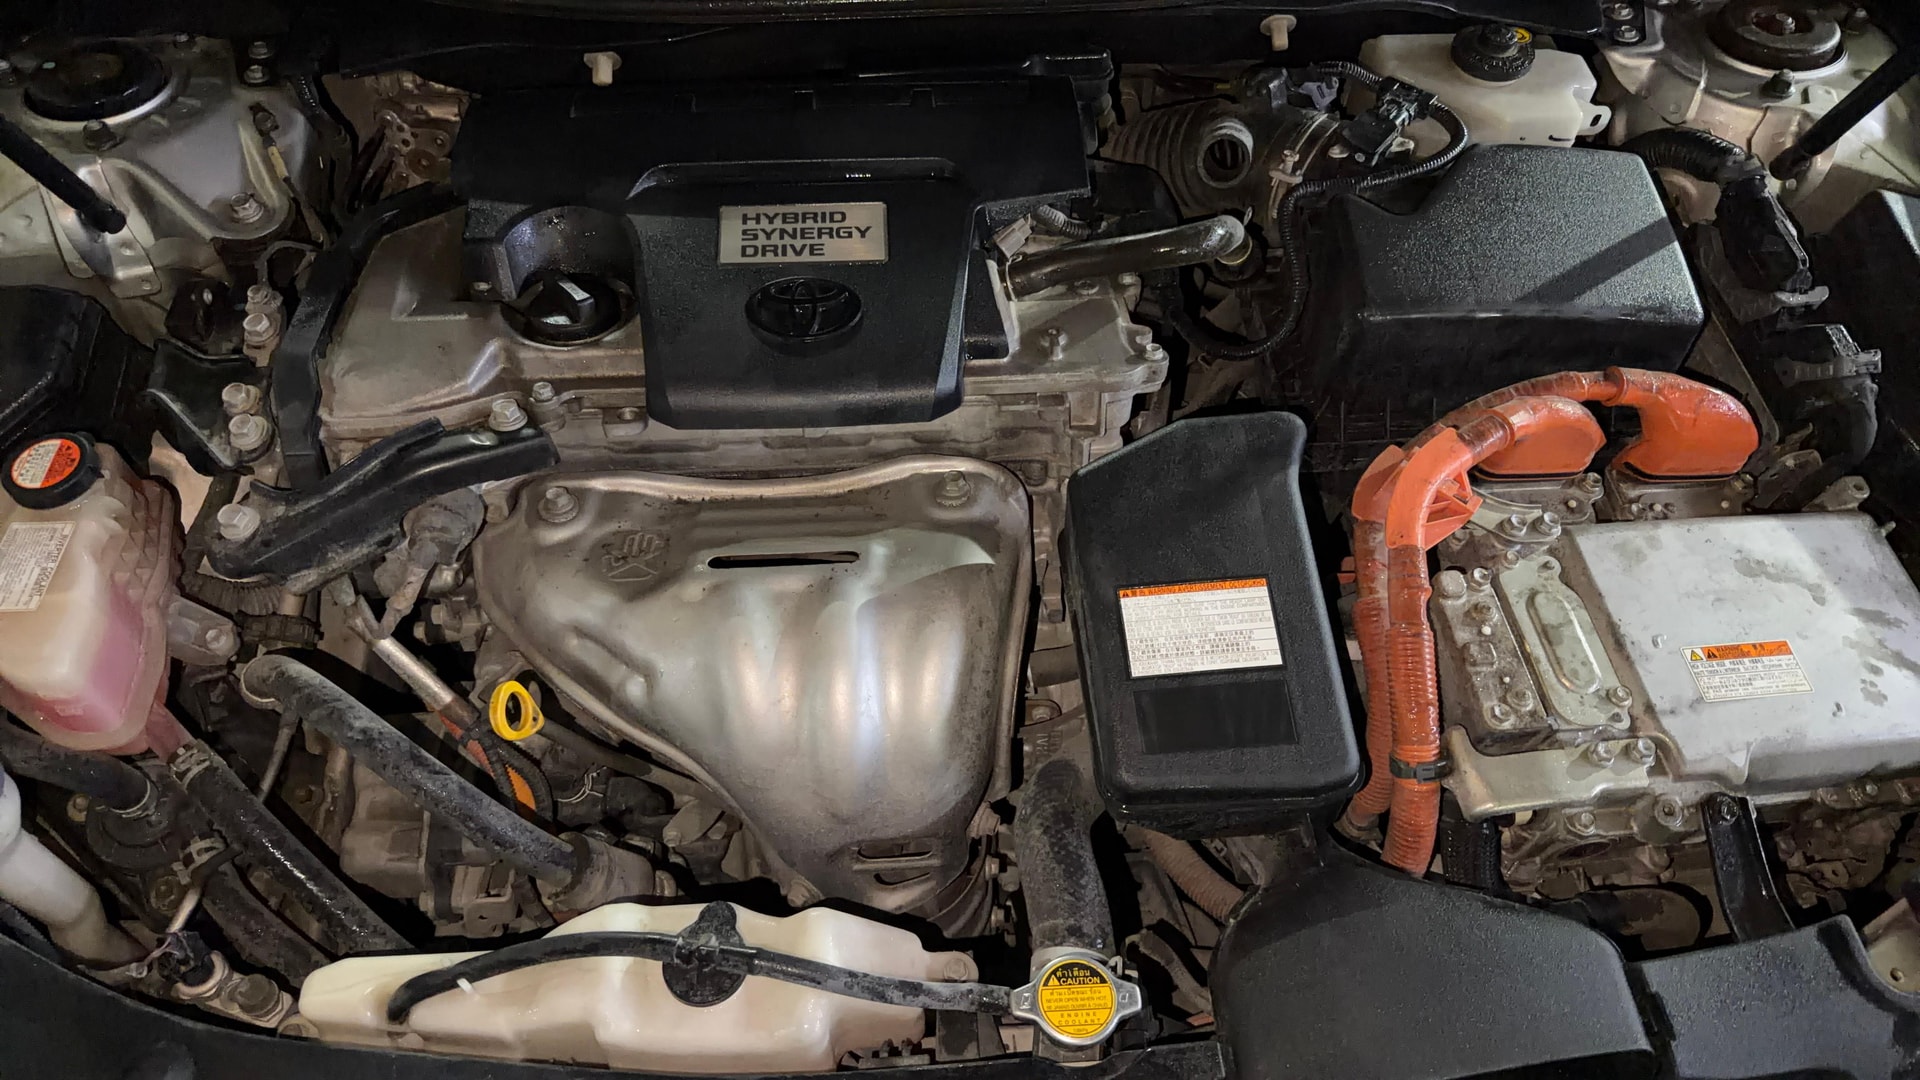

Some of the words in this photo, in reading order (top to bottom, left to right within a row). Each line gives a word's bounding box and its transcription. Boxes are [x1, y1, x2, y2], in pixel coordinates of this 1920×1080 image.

[742, 211, 847, 225] HYBRID
[741, 226, 872, 241] SYNERGY
[741, 243, 825, 257] DRIVE
[1148, 586, 1176, 595] WARNING
[1060, 976, 1100, 985] CAUTION
